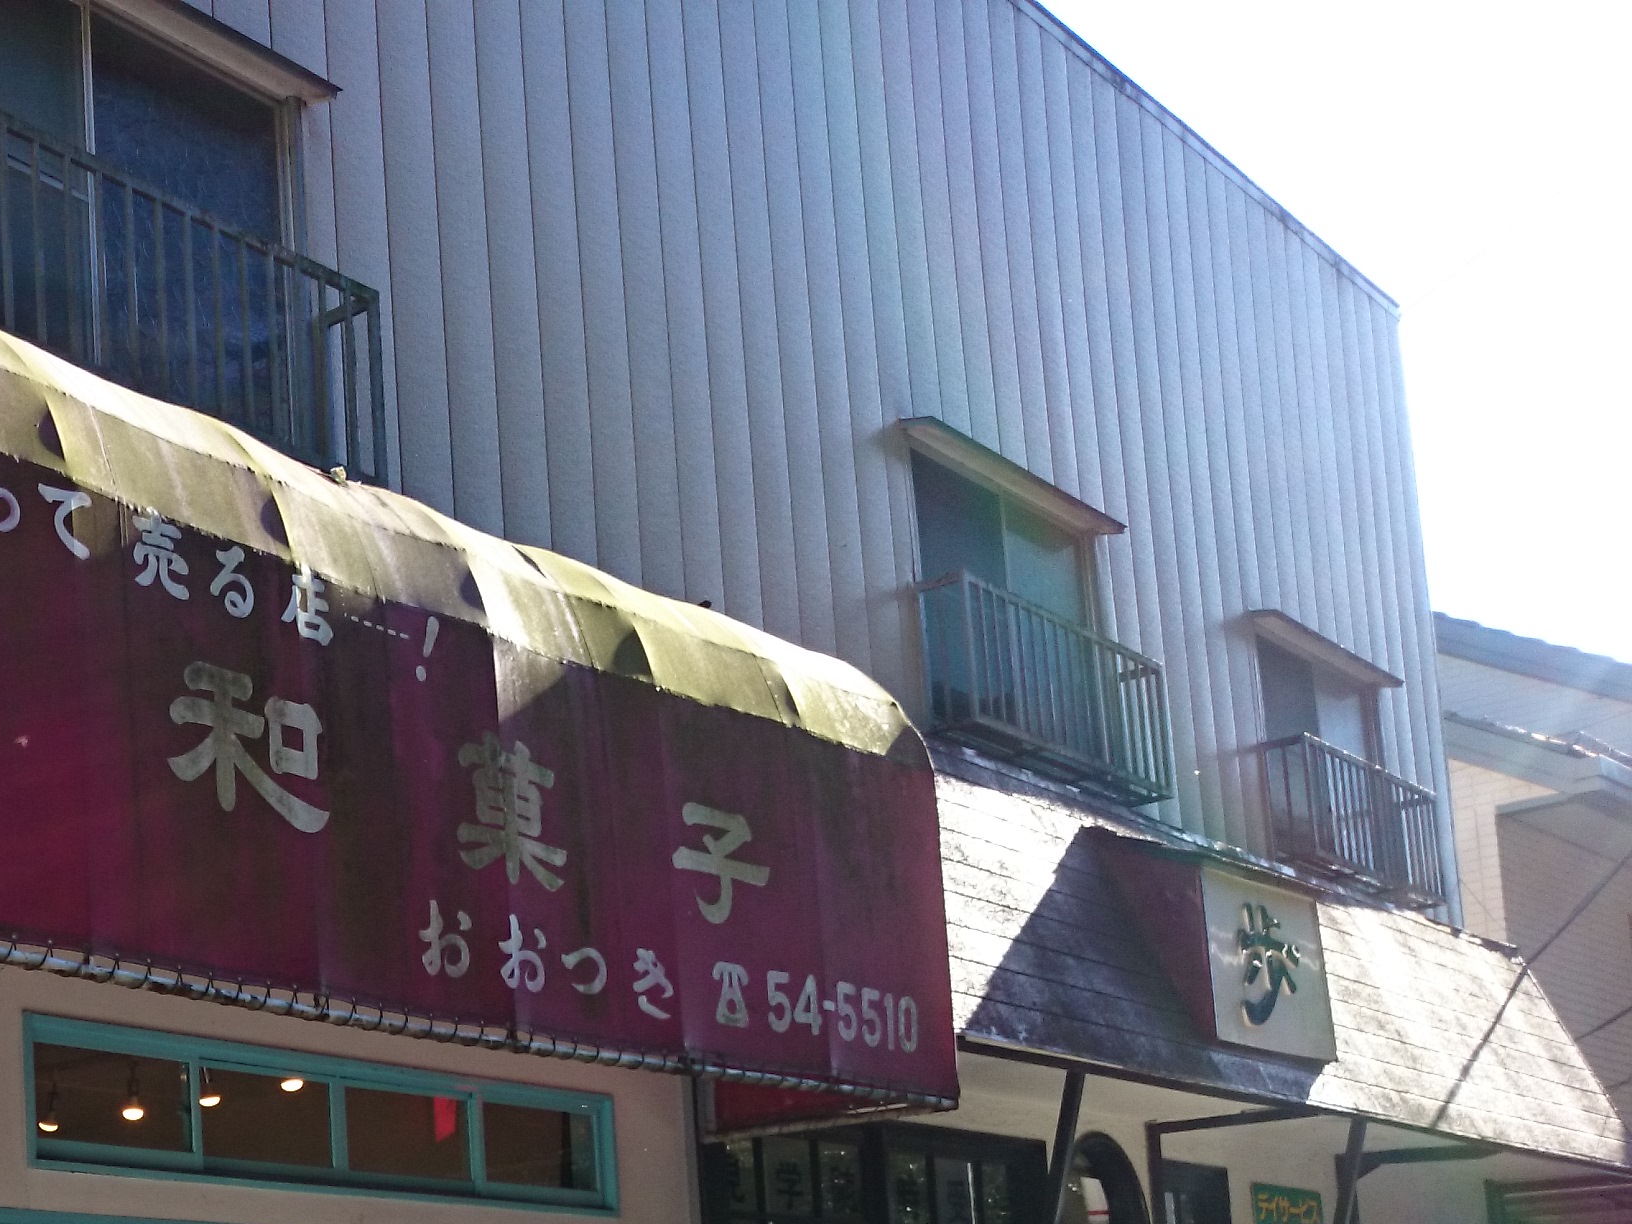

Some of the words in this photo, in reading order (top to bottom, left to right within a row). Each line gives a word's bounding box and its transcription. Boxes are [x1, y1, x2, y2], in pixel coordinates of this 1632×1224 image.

[167, 661, 770, 925] 和菓子
[418, 898, 674, 1021] おおつき
[767, 970, 919, 1054] 54-5510
